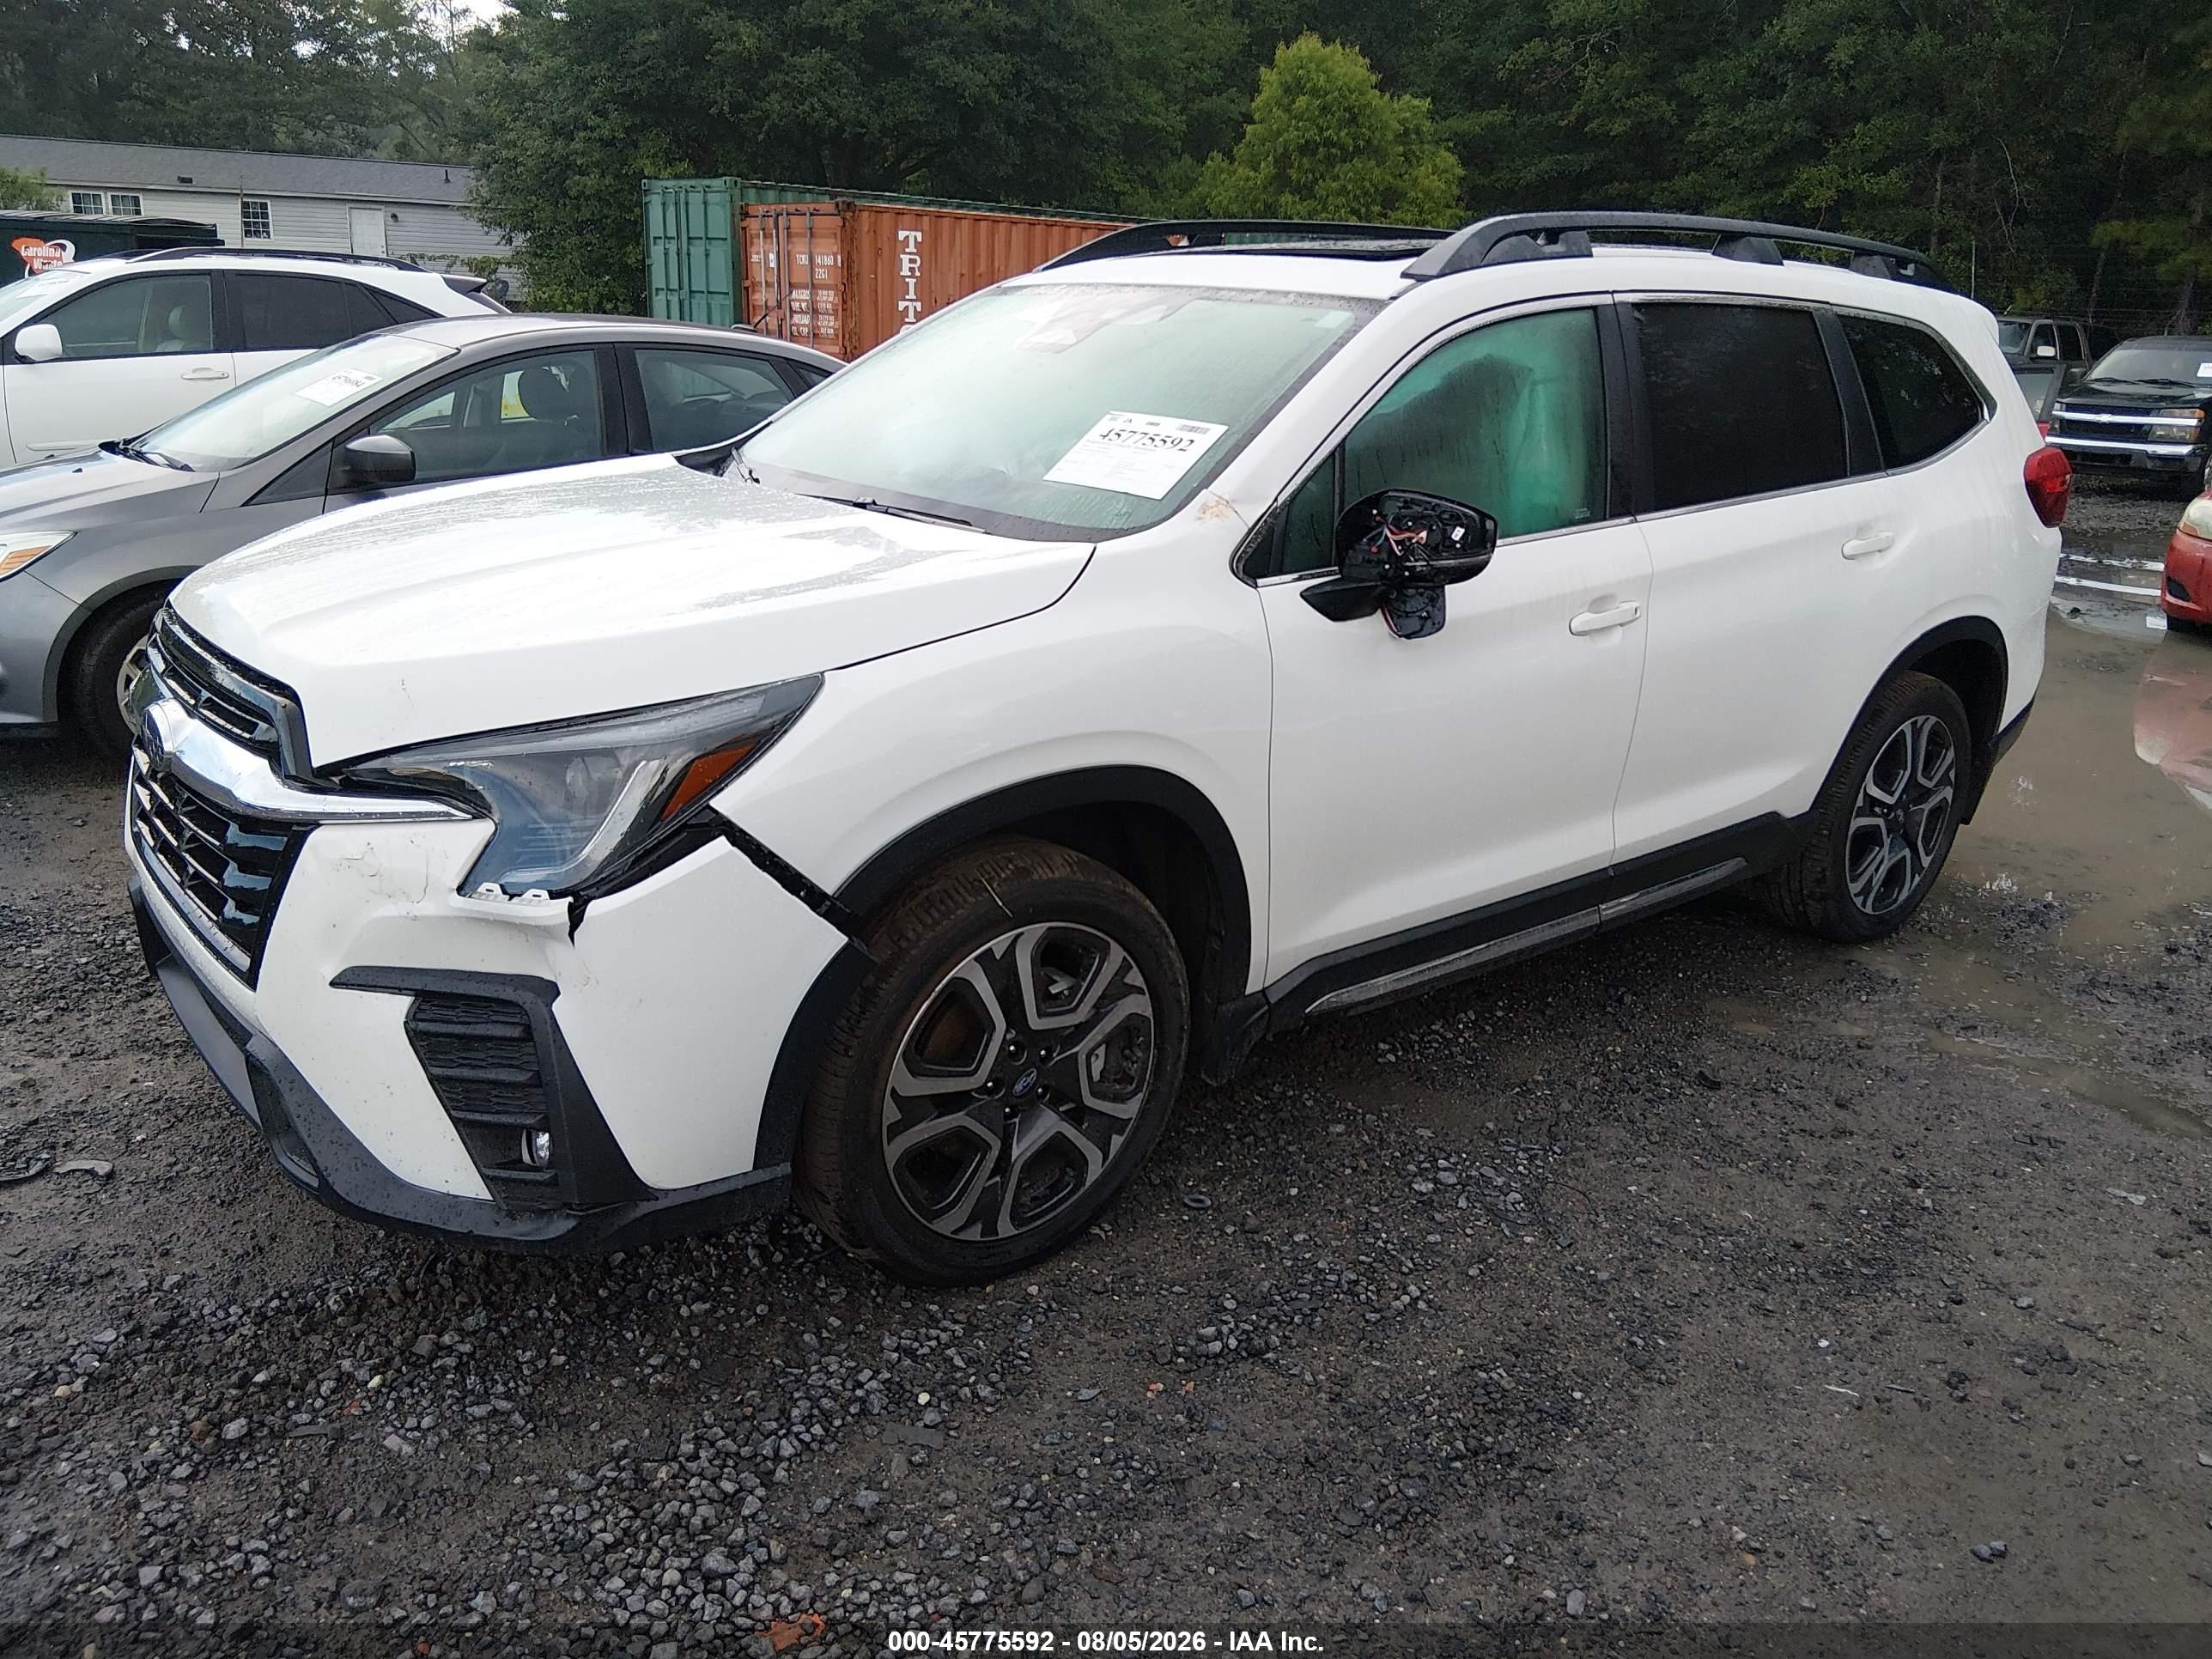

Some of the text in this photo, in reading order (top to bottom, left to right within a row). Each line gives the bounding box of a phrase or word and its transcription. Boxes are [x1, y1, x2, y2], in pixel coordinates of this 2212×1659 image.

[21, 245, 61, 258] Carolina
[33, 258, 63, 270] Waste
[815, 254, 834, 266] 141860
[1098, 428, 1195, 453] 45775592
